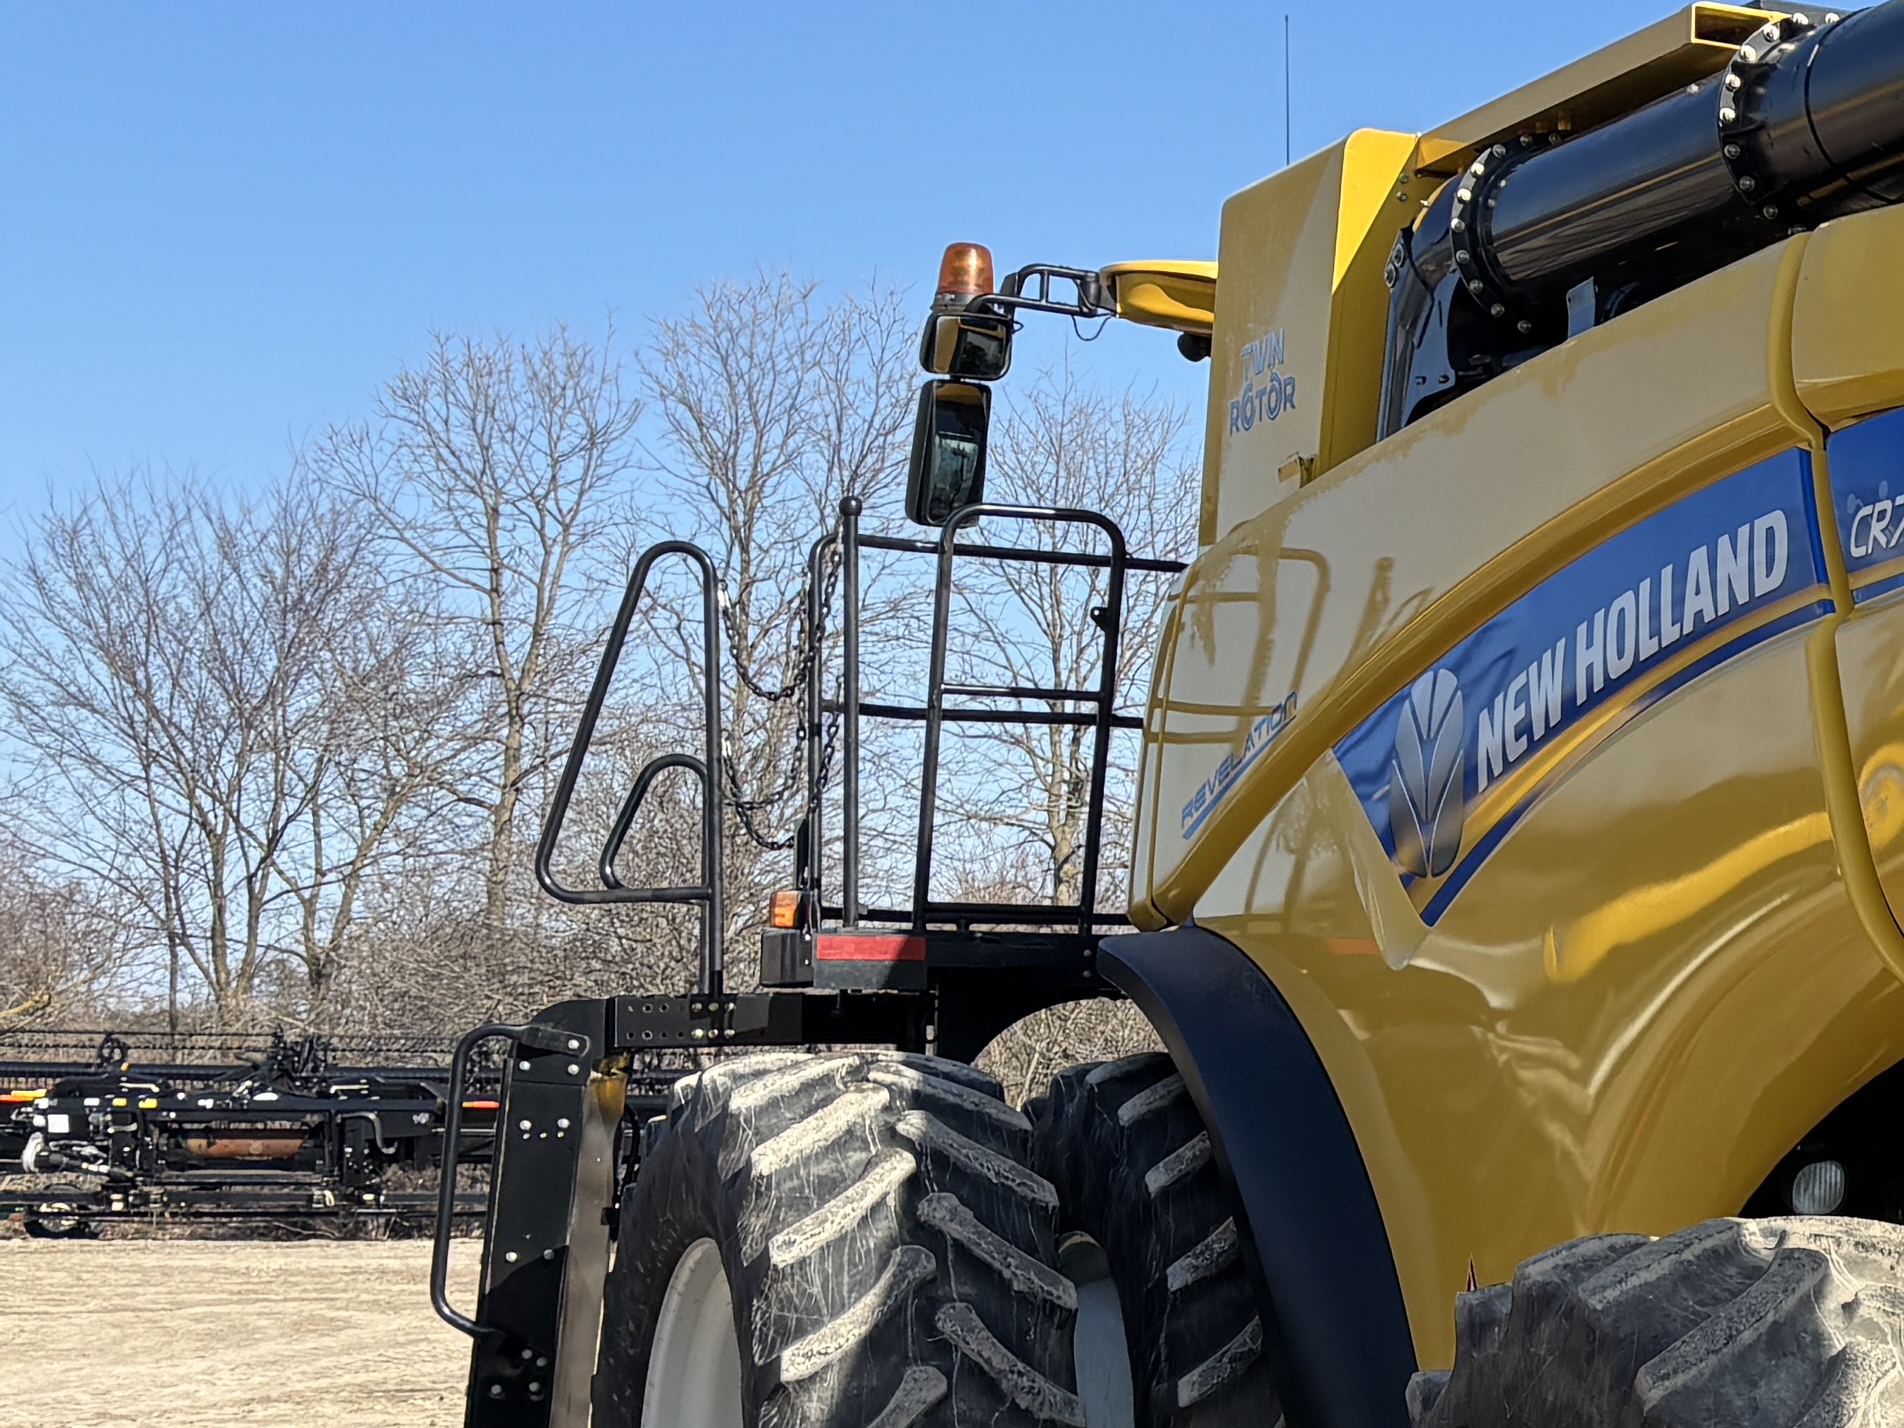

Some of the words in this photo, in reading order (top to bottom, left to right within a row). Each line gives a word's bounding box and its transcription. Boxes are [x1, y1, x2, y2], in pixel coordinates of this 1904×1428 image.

[1229, 371, 1296, 437] ROTOR
[1476, 637, 1567, 794] NEW
[1576, 508, 1790, 708] HOLLAND
[1181, 690, 1298, 830] REVELATION
